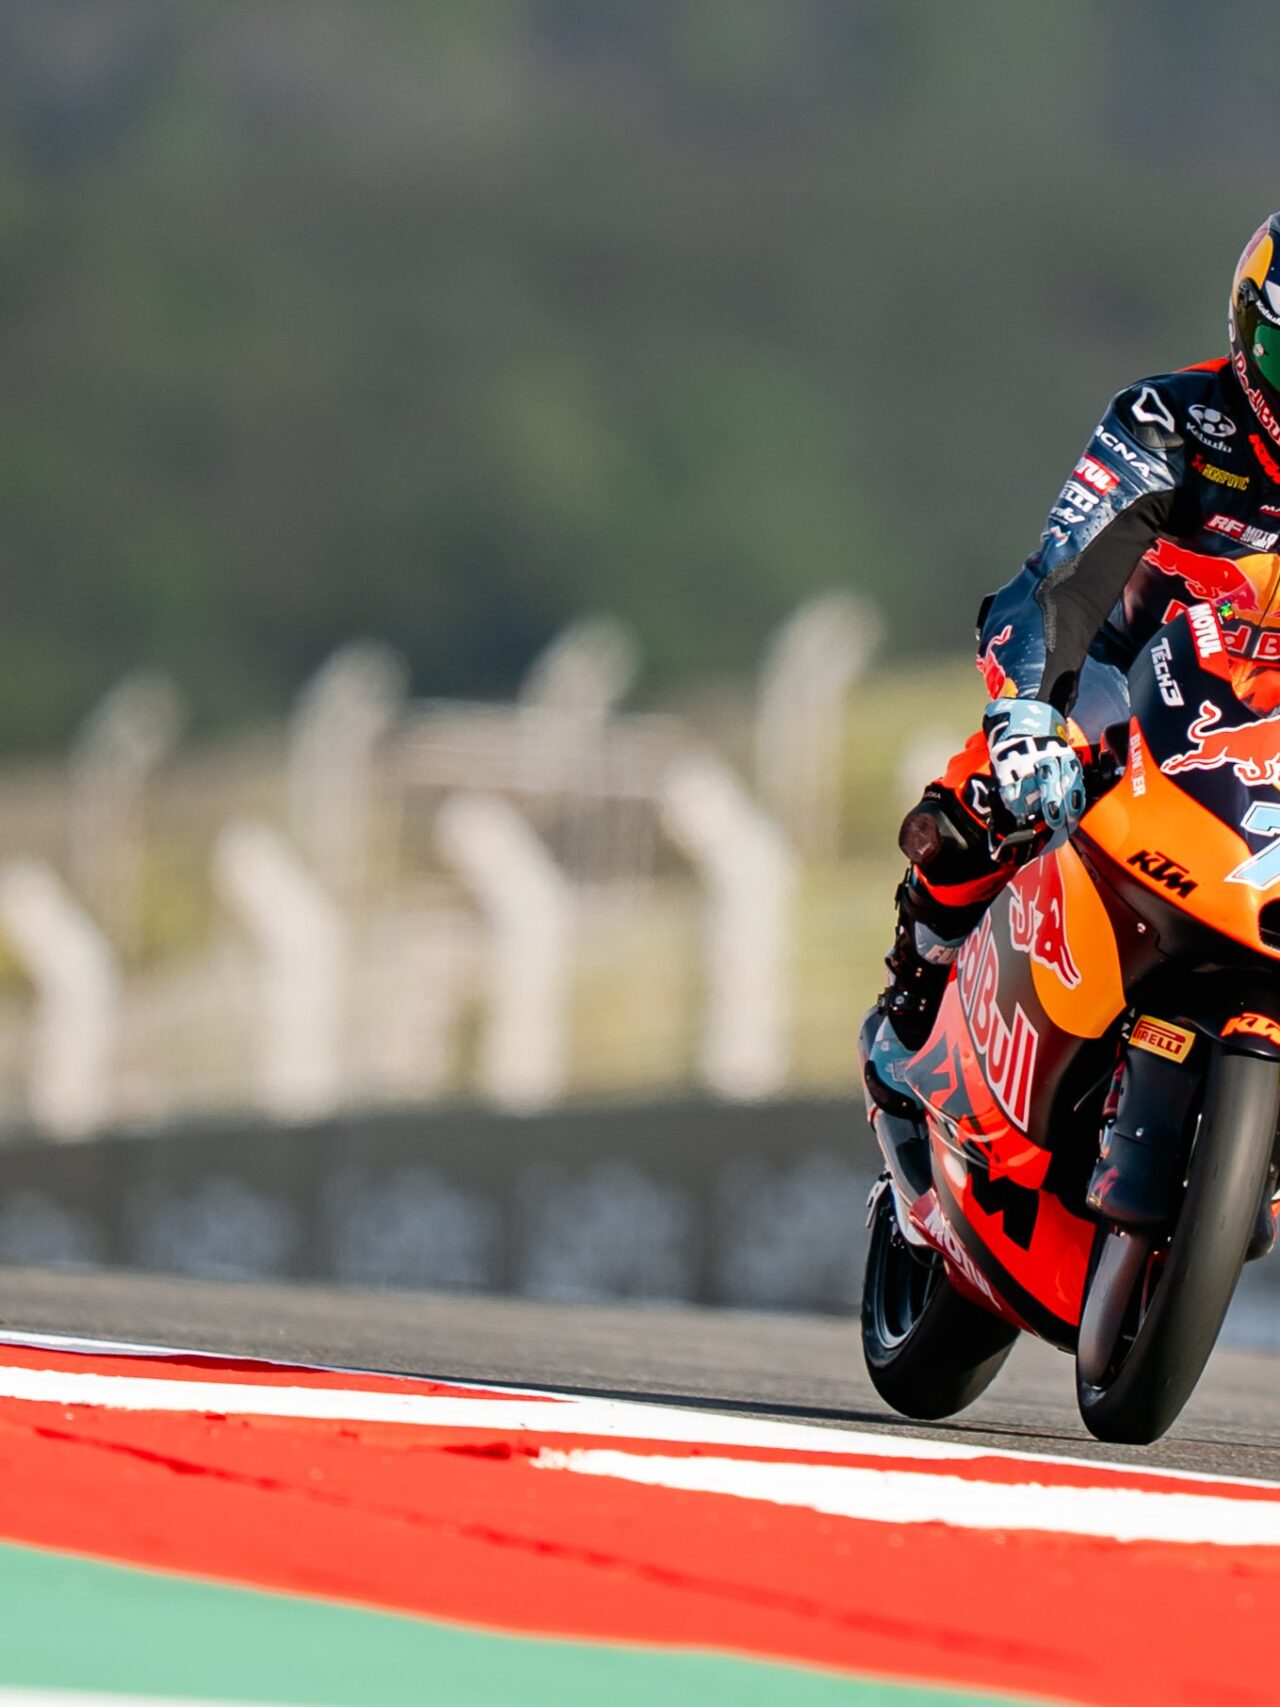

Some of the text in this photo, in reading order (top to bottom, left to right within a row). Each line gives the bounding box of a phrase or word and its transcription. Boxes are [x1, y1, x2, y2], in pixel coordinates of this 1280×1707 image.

[1207, 514, 1246, 533] RF
[1188, 602, 1222, 658] MOTUL
[1151, 637, 1185, 707] TECH3
[1127, 850, 1198, 898] KTM
[969, 930, 1038, 1133] Bull
[1132, 1020, 1186, 1054] PIRELLI
